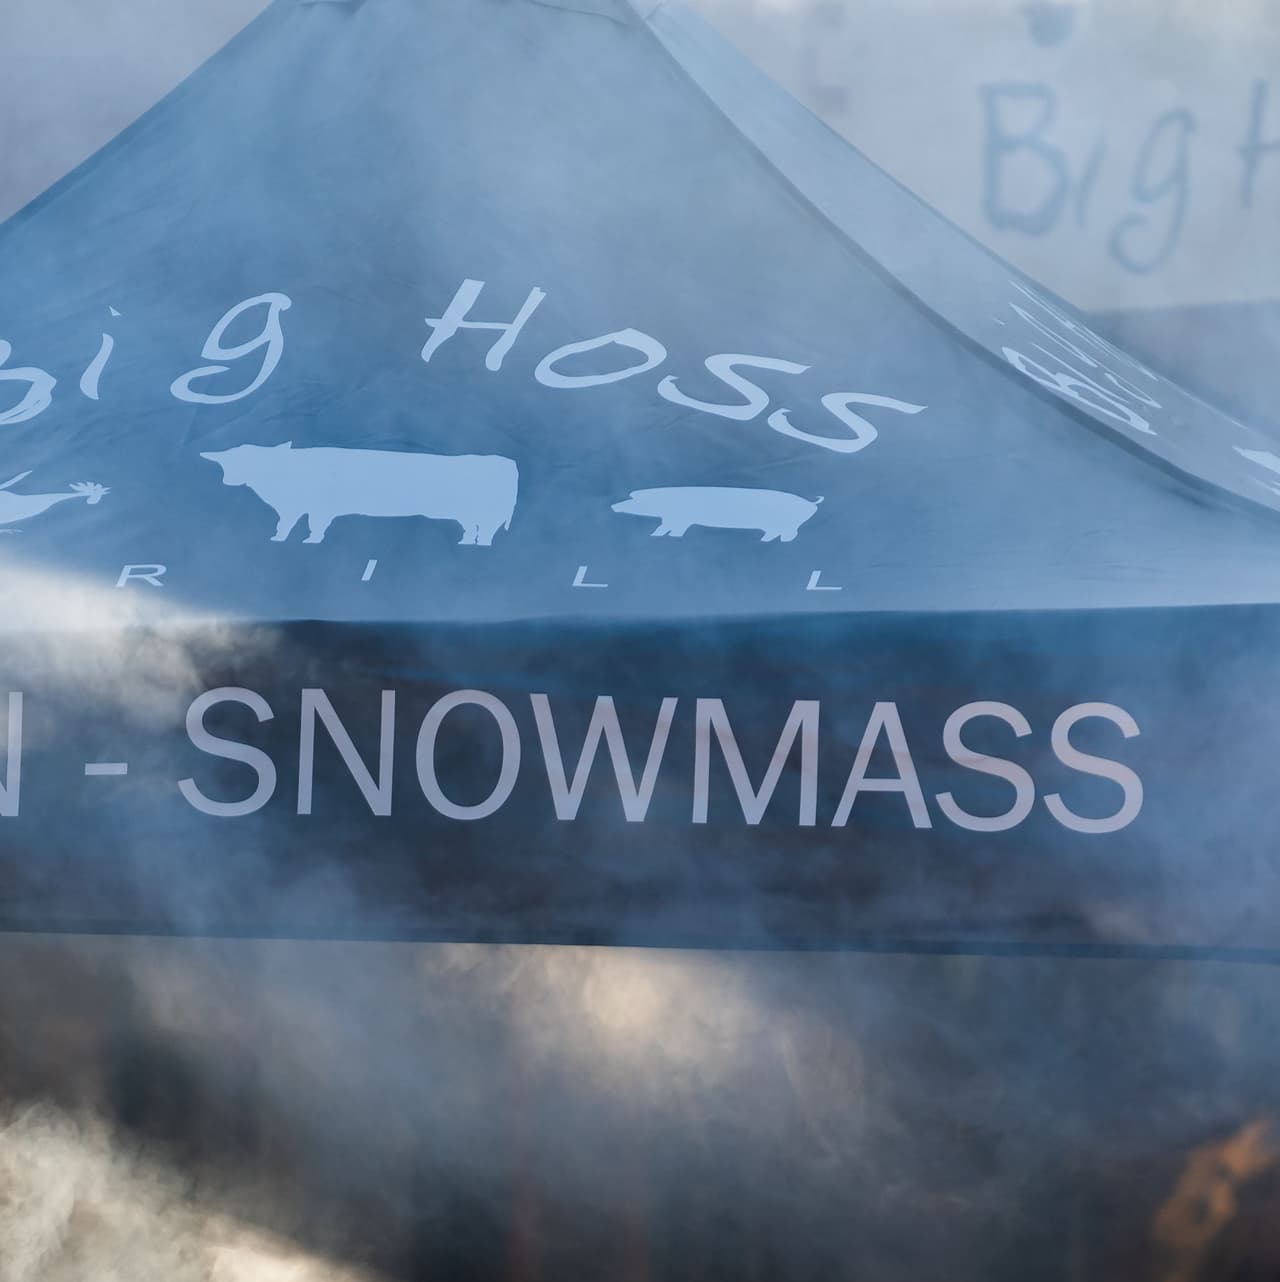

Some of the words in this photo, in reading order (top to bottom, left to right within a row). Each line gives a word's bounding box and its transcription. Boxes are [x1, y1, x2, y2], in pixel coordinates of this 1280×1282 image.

[978, 80, 1196, 275] Big
[84, 762, 128, 776] -
[177, 686, 1144, 834] SNOWMASS
